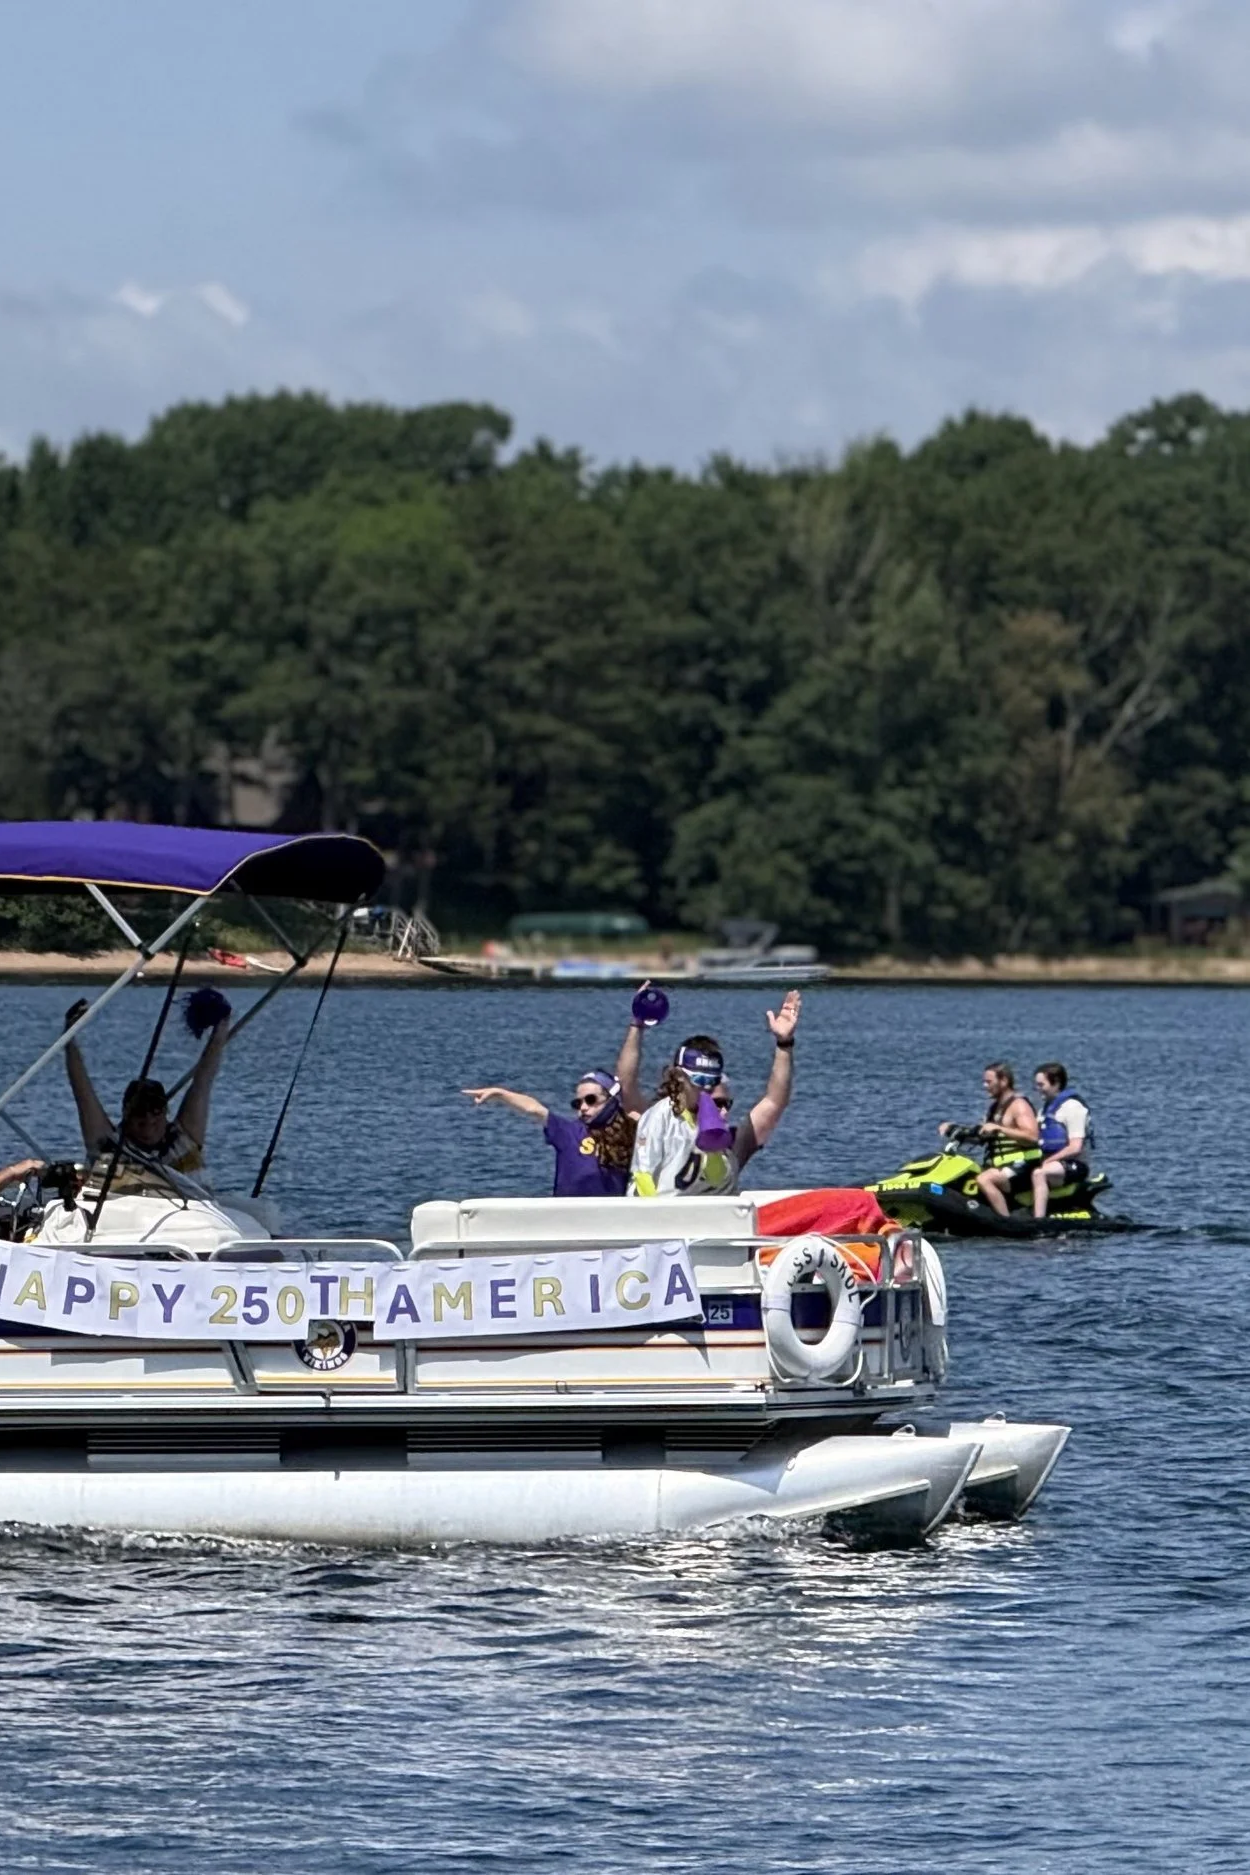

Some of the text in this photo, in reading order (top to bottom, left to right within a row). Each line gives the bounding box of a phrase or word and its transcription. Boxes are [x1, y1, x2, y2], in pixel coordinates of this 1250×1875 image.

[208, 1275, 374, 1325] 250TH
[386, 1263, 695, 1324] AMERICA
[710, 1304, 730, 1320] 25
